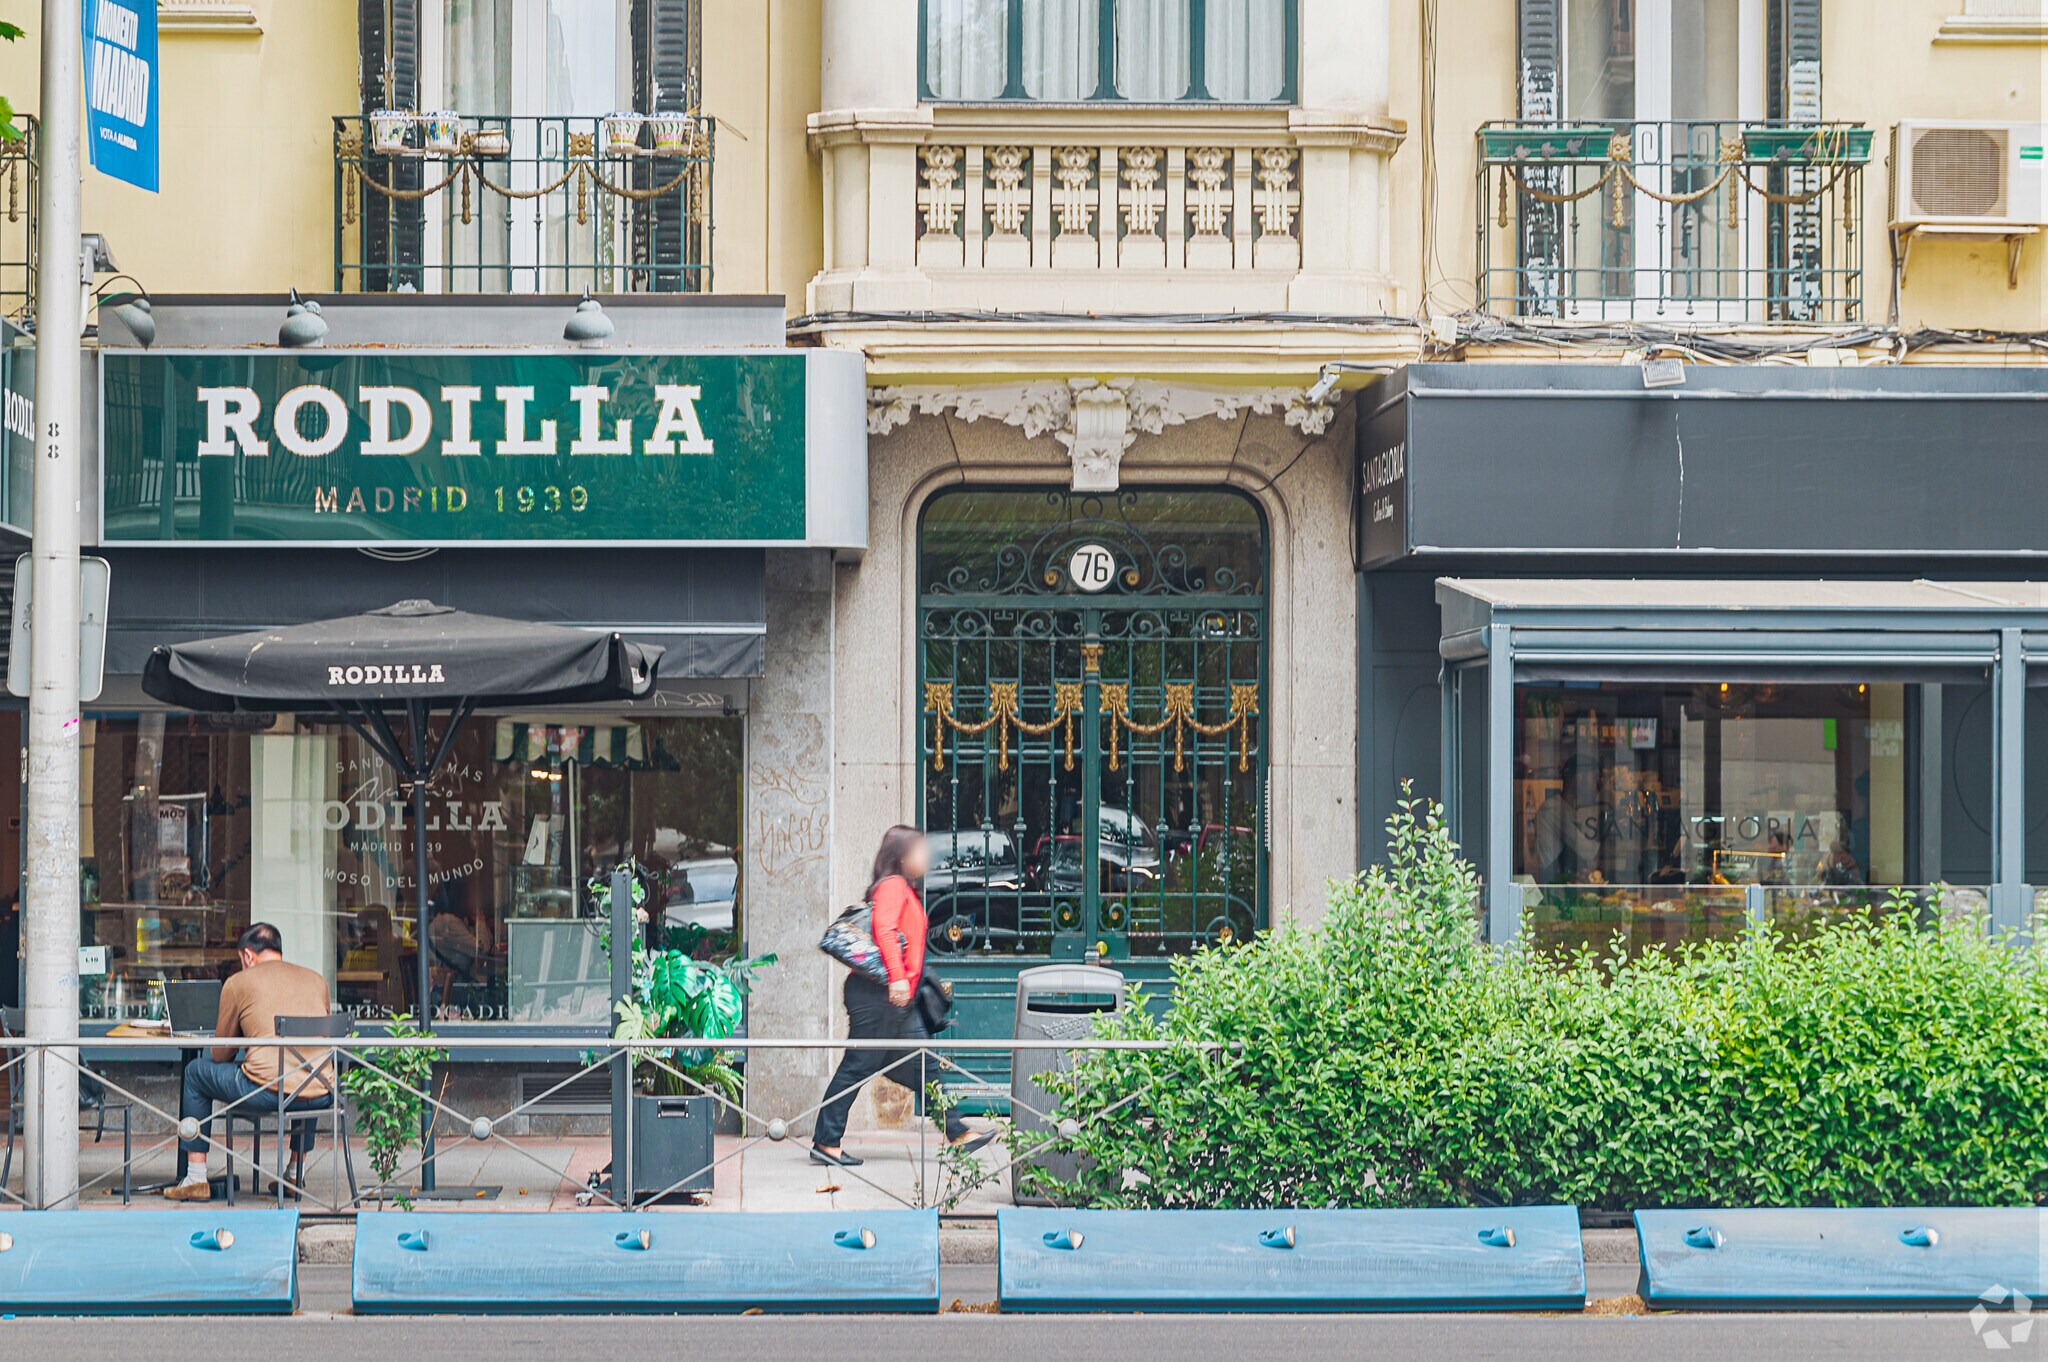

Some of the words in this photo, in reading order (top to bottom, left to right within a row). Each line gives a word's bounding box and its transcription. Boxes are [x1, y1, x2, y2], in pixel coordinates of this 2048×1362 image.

[92, 40, 149, 127] MADRID
[4, 387, 35, 442] RODIL
[197, 384, 714, 456] RODILLA
[315, 486, 467, 513] MADRID
[494, 485, 588, 512] 1939
[1077, 552, 1108, 582] 76
[328, 664, 445, 685] RODILLA
[336, 756, 384, 774] SAND
[1584, 815, 1817, 840] SANGLORIA
[350, 842, 402, 852] MADRID
[410, 842, 442, 852] 139
[324, 867, 371, 886] MOSO
[386, 876, 416, 888] DEL
[428, 857, 484, 884] MUNDO
